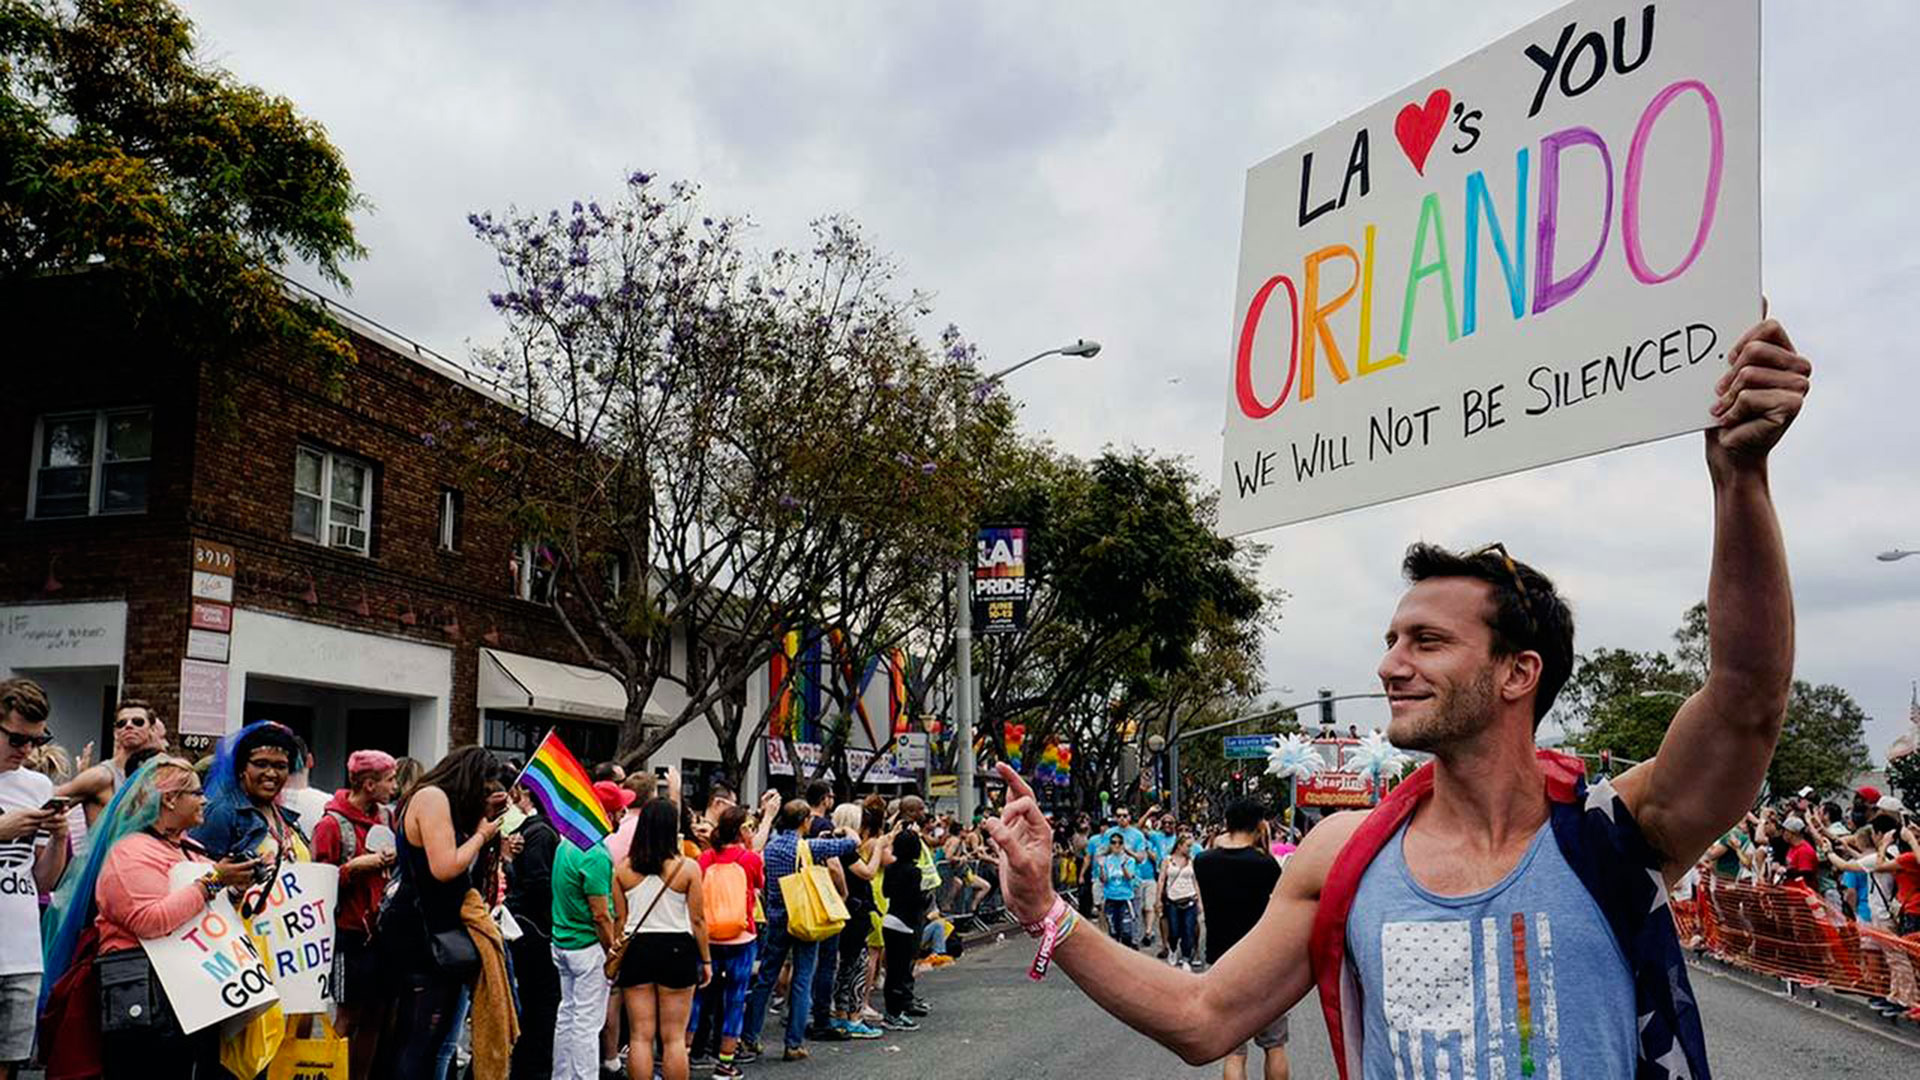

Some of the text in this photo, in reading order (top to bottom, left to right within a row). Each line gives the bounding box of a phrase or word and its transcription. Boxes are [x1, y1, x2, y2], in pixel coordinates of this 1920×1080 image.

[1299, 129, 1369, 227] LA
[1524, 4, 1656, 117] YOU
[1235, 79, 1724, 419] ORLANDO
[1234, 323, 1724, 498] WE WILL NOT BE SILENCED.
[196, 548, 231, 567] 8919
[976, 578, 1025, 595] PRIDE
[181, 912, 228, 952] TO
[276, 938, 331, 977] RIDE
